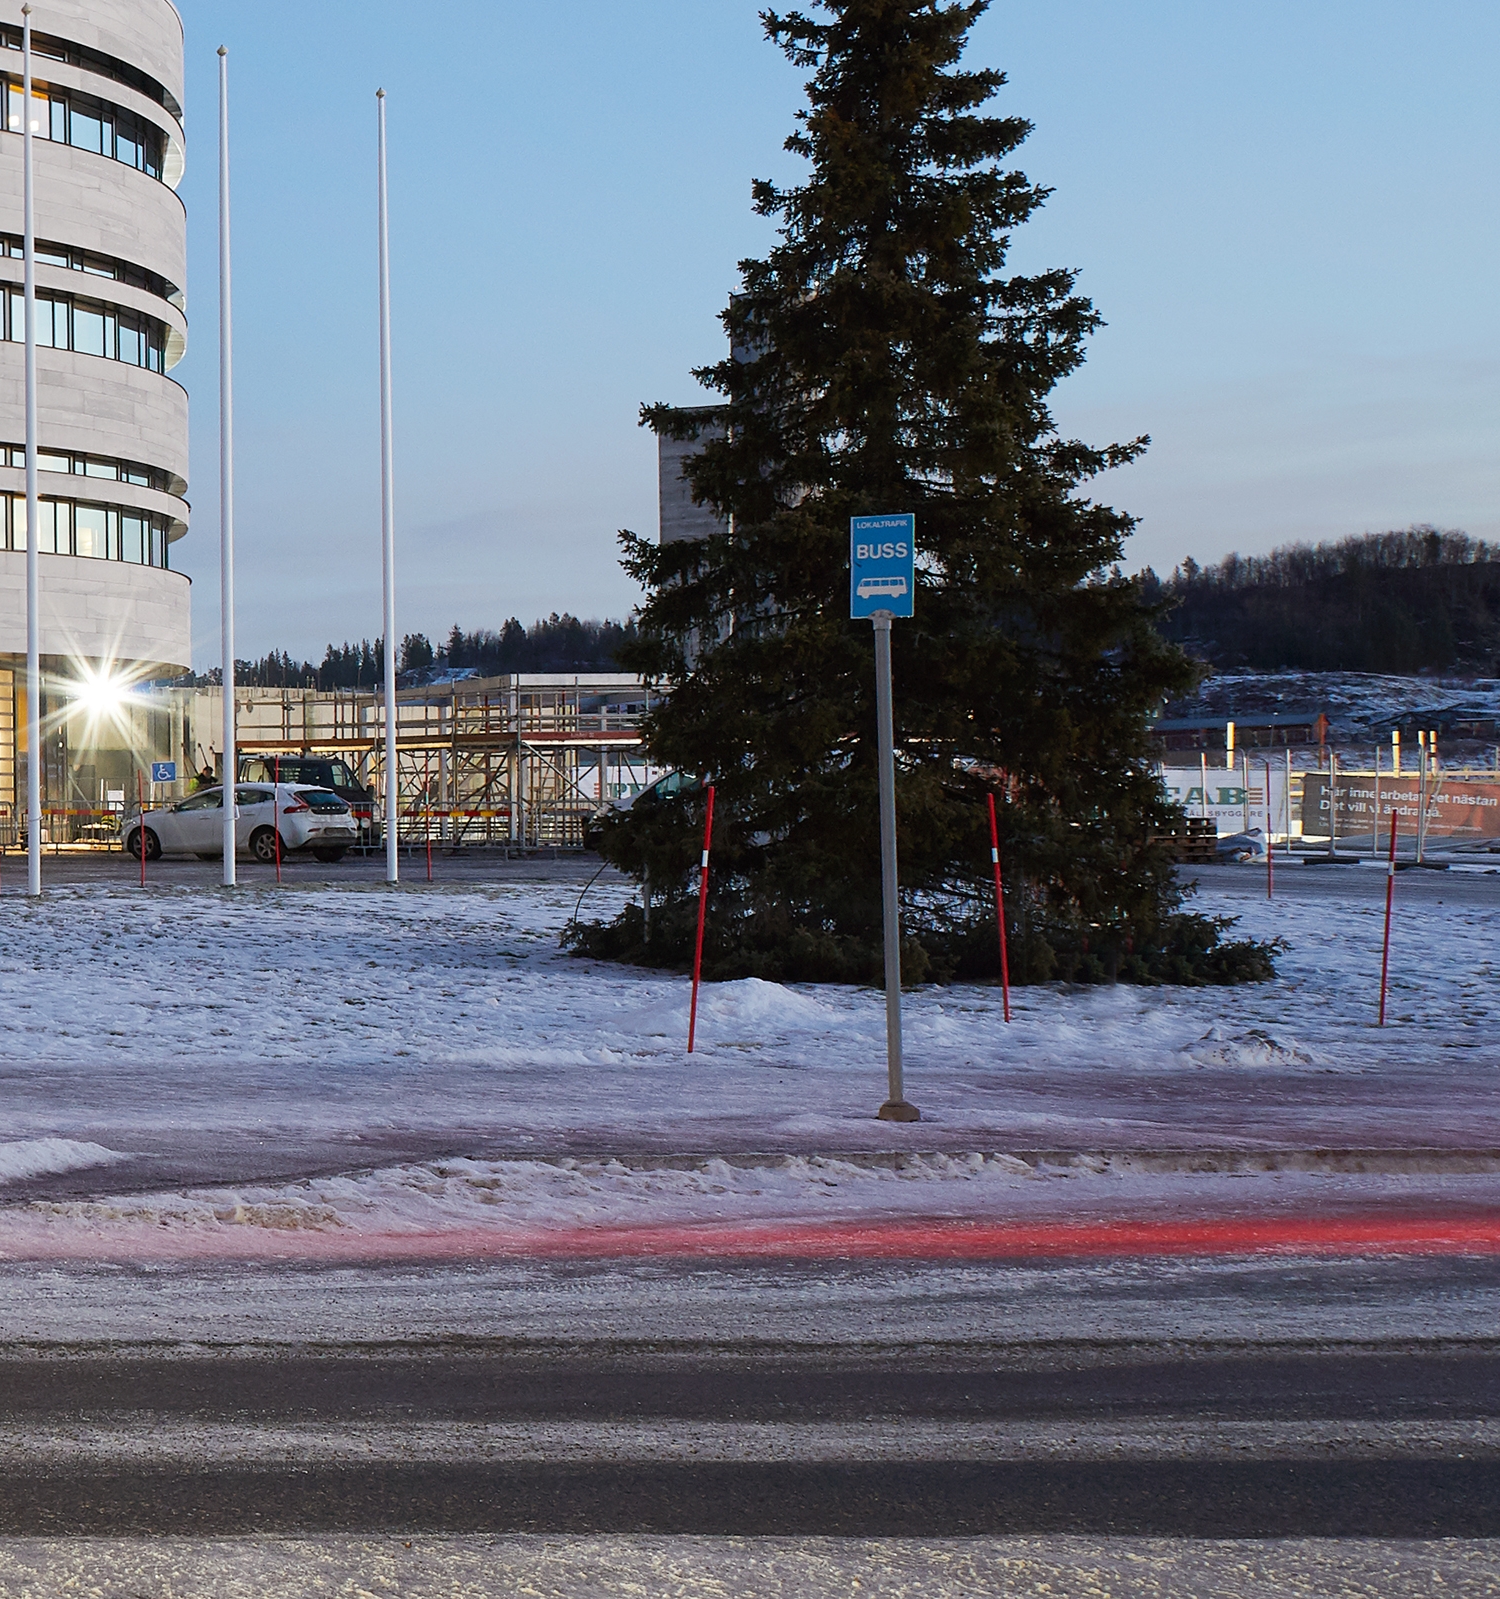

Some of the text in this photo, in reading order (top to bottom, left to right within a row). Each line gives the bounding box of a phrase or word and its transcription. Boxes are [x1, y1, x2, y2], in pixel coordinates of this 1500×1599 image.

[857, 520, 907, 529] LOKALTRAFIK
[857, 542, 908, 559] BUSS
[1163, 786, 1246, 805] EAB
[1452, 794, 1498, 807] nästan
[1347, 802, 1367, 813] vill
